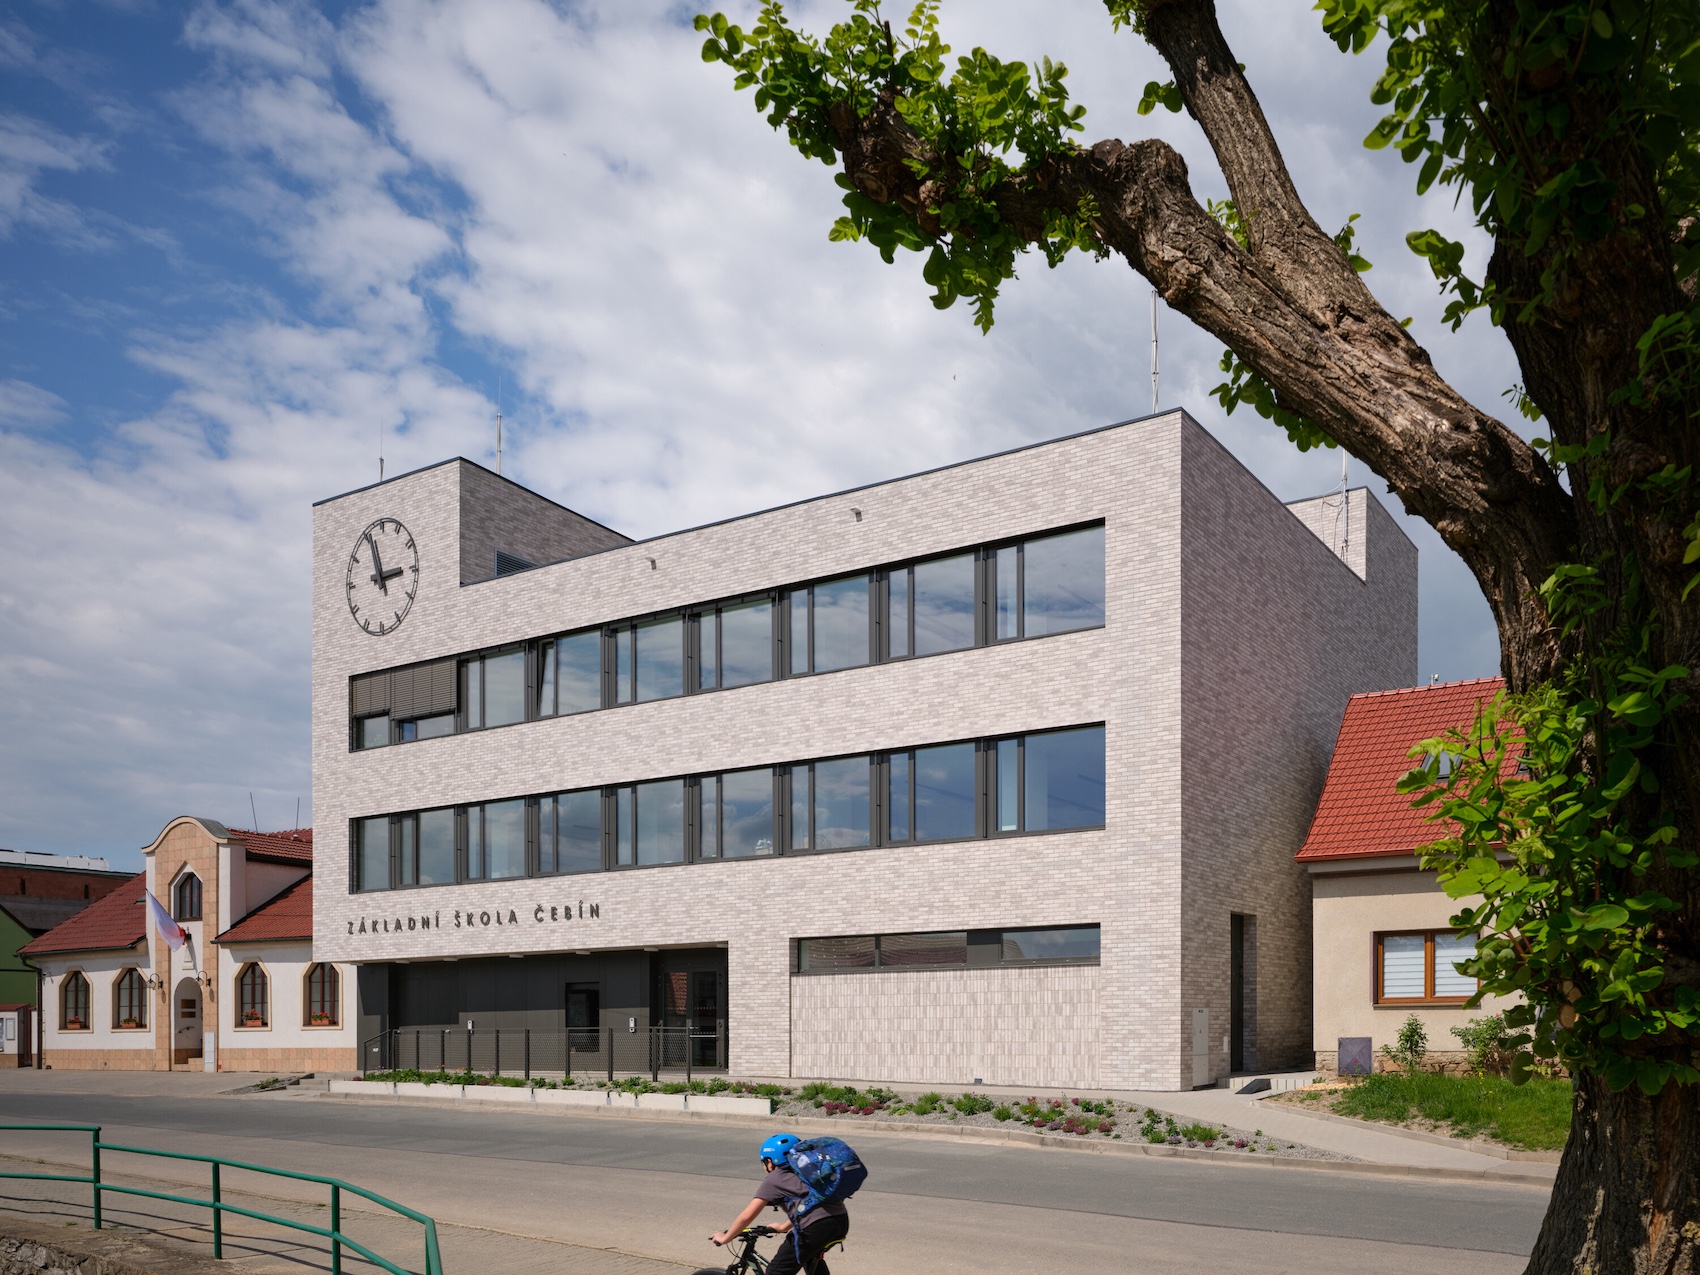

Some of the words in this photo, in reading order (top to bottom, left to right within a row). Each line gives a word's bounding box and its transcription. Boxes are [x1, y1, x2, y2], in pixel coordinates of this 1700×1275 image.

[347, 910, 440, 935] ZÁKLADNÍ
[454, 909, 518, 929] ŠKOLA
[533, 900, 600, 923] ČEBÍN
